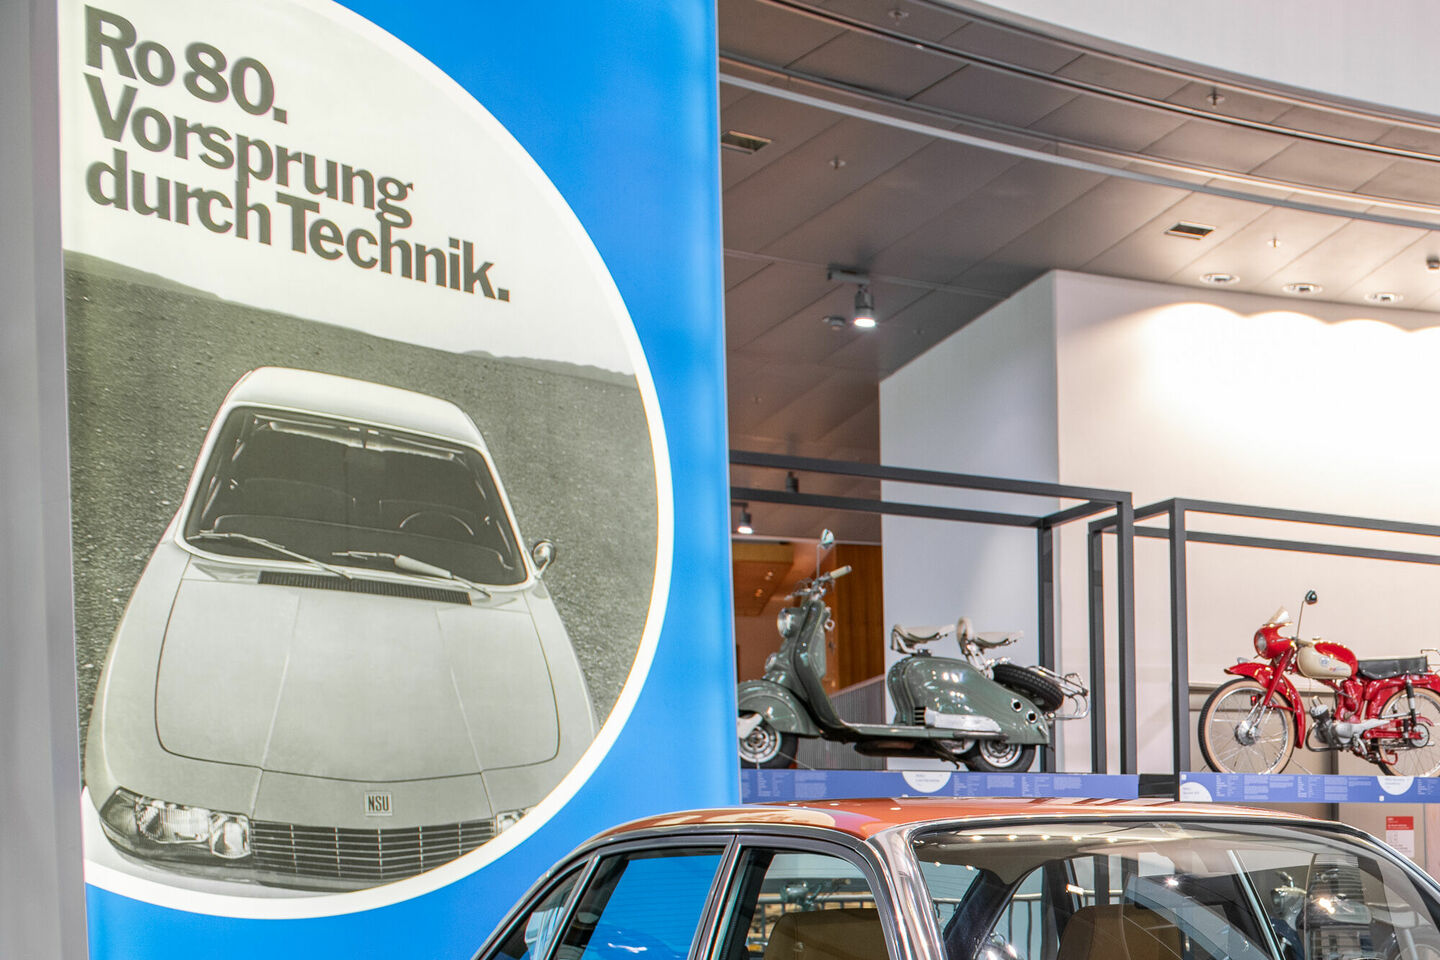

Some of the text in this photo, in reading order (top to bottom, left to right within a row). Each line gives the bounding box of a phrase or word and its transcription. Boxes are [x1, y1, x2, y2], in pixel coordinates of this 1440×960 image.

[84, 4, 289, 124] Ro 80.
[82, 72, 414, 229] Vorsprung
[85, 148, 511, 303] durch Technik.
[368, 795, 390, 812] NSU
